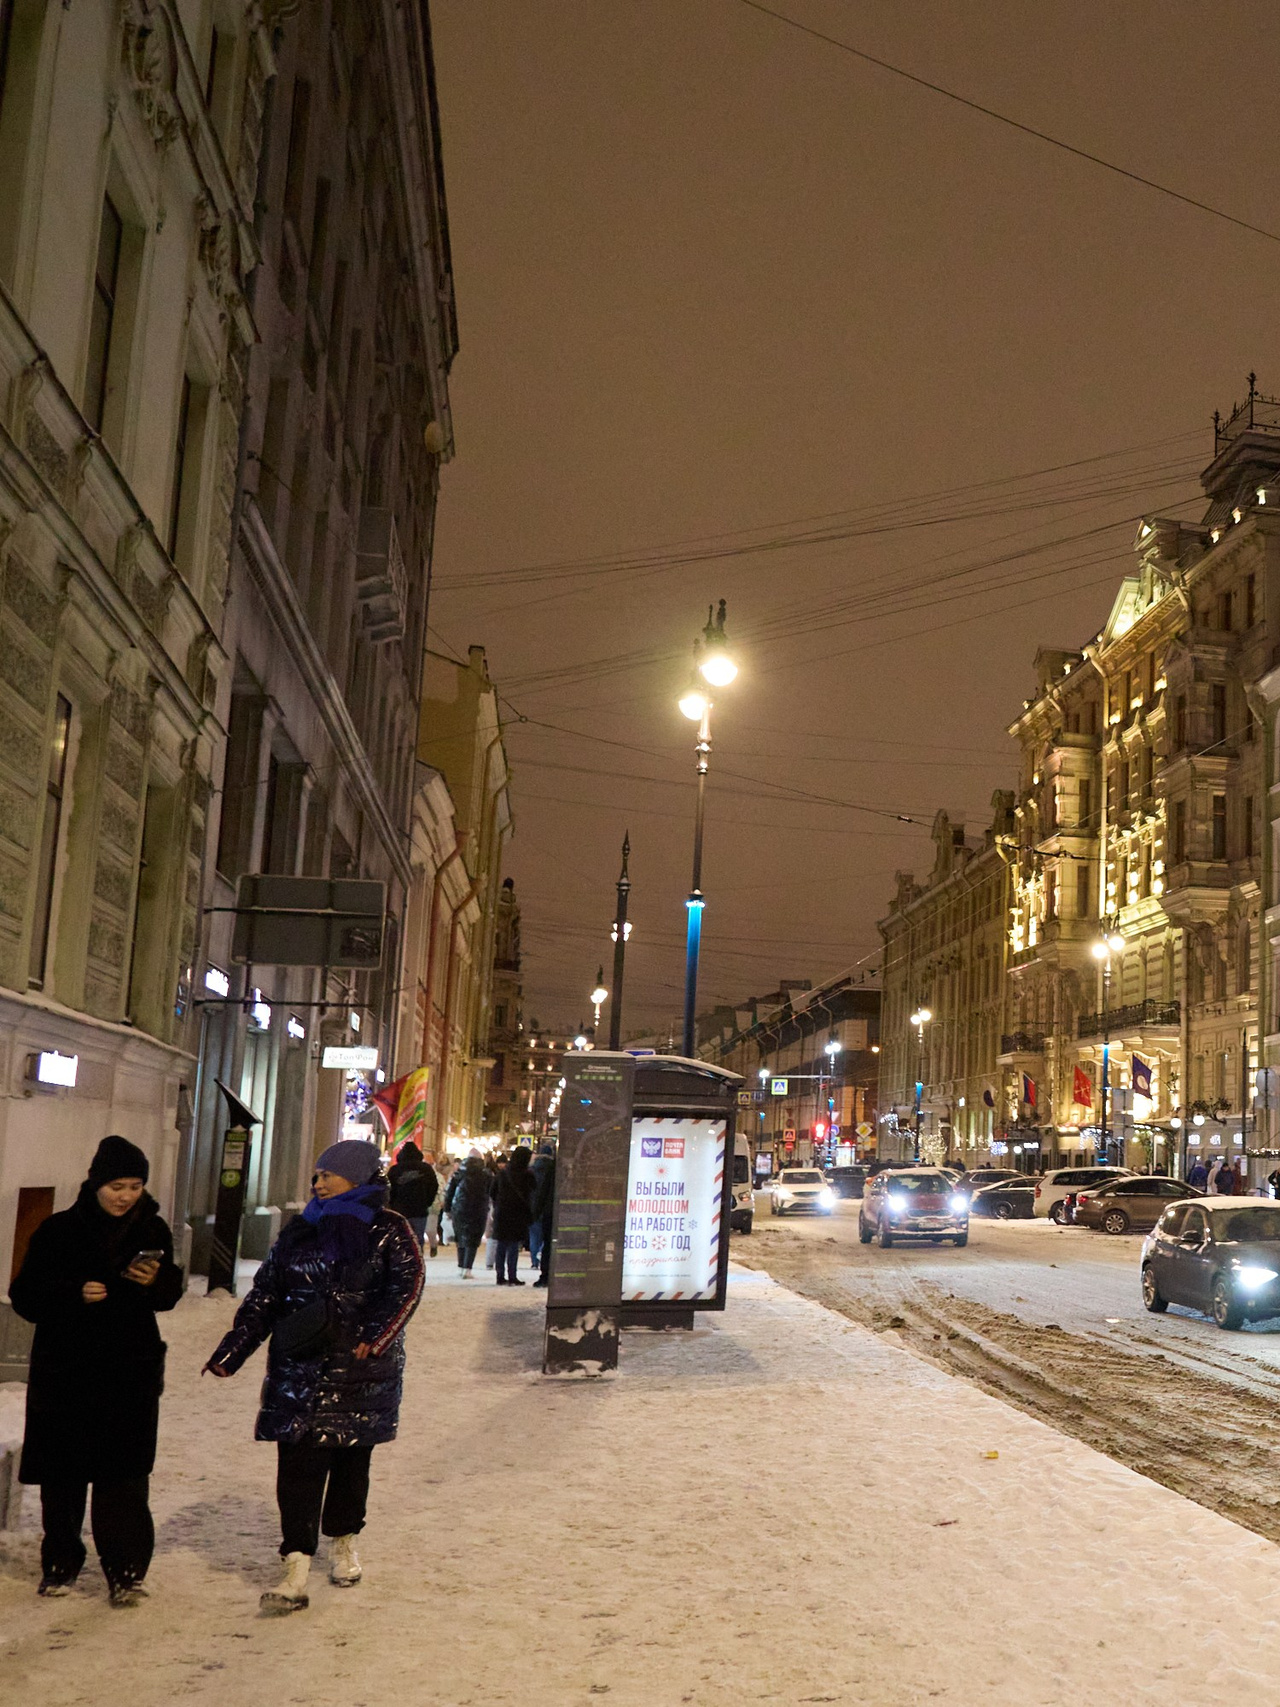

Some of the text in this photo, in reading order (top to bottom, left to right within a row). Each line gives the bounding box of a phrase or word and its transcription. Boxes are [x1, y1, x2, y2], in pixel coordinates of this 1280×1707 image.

[635, 1181, 685, 1196] ВЫ БЫЛИ
[628, 1199, 689, 1215] МОЛОДЦОМ
[630, 1217, 685, 1232] НА РАБОТЕ
[670, 1235, 691, 1251] ГОД
